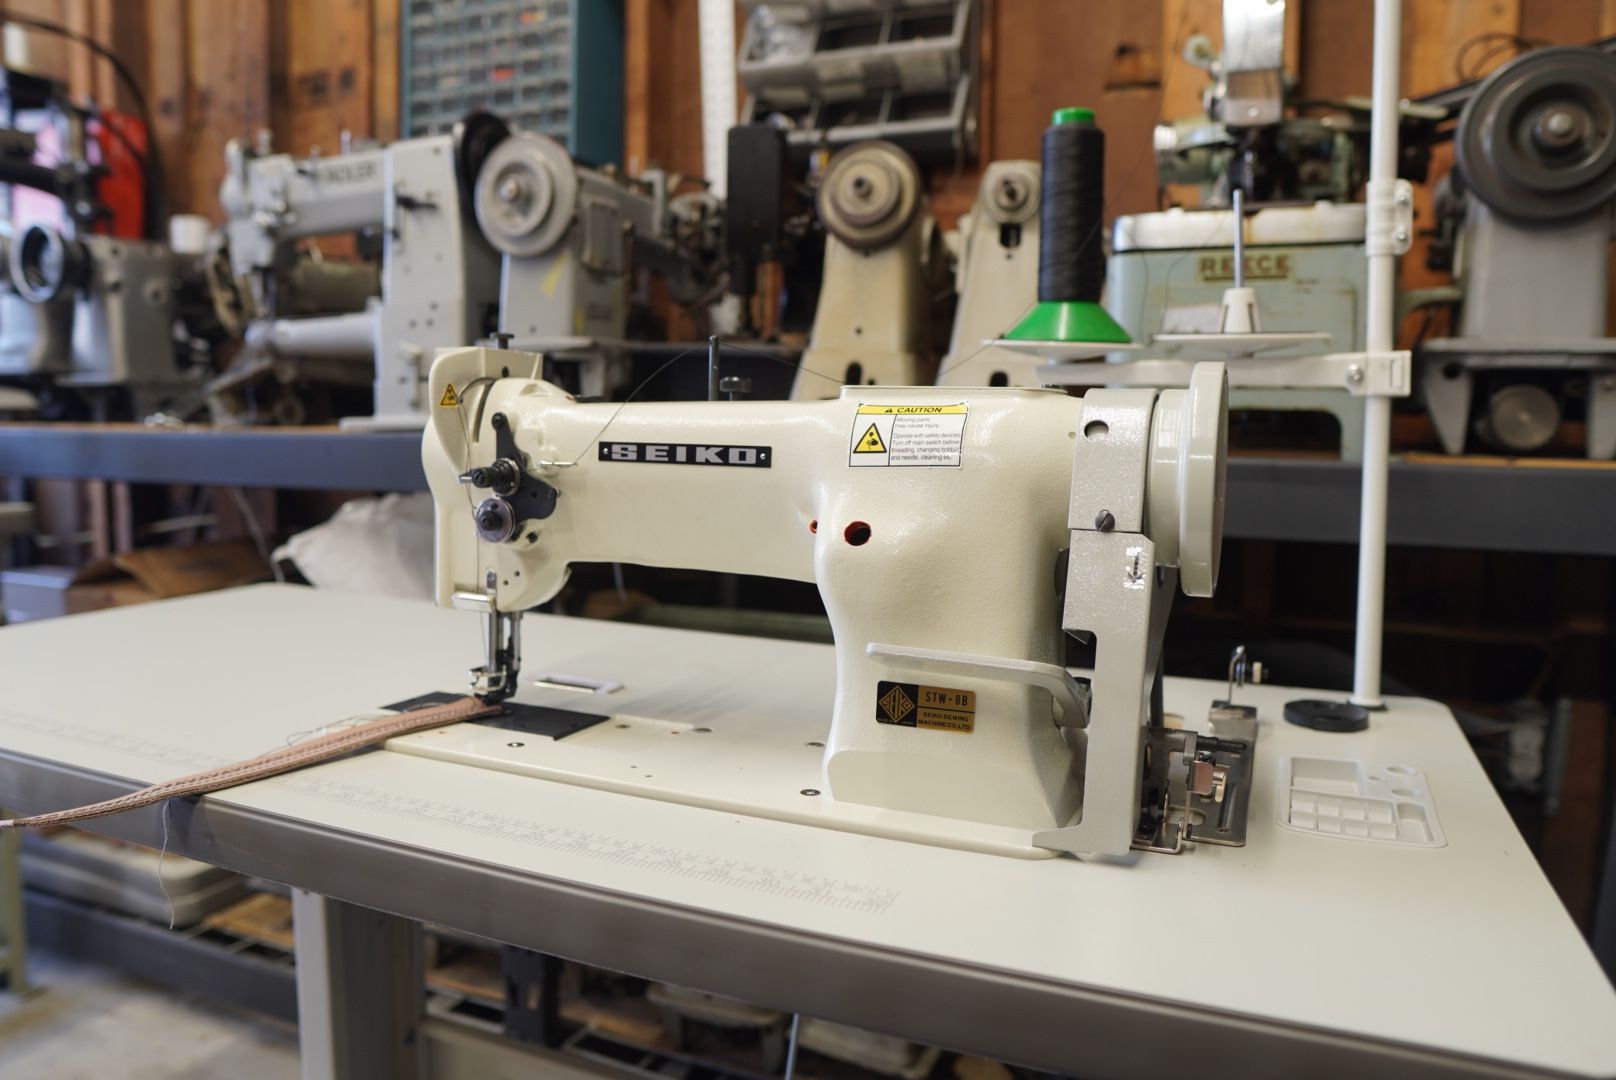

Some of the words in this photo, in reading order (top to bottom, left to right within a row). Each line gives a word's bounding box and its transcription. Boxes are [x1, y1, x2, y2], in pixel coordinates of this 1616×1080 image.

[611, 443, 757, 465] SEIKO
[923, 711, 942, 719] SEIKO
[943, 713, 969, 722] SEWING
